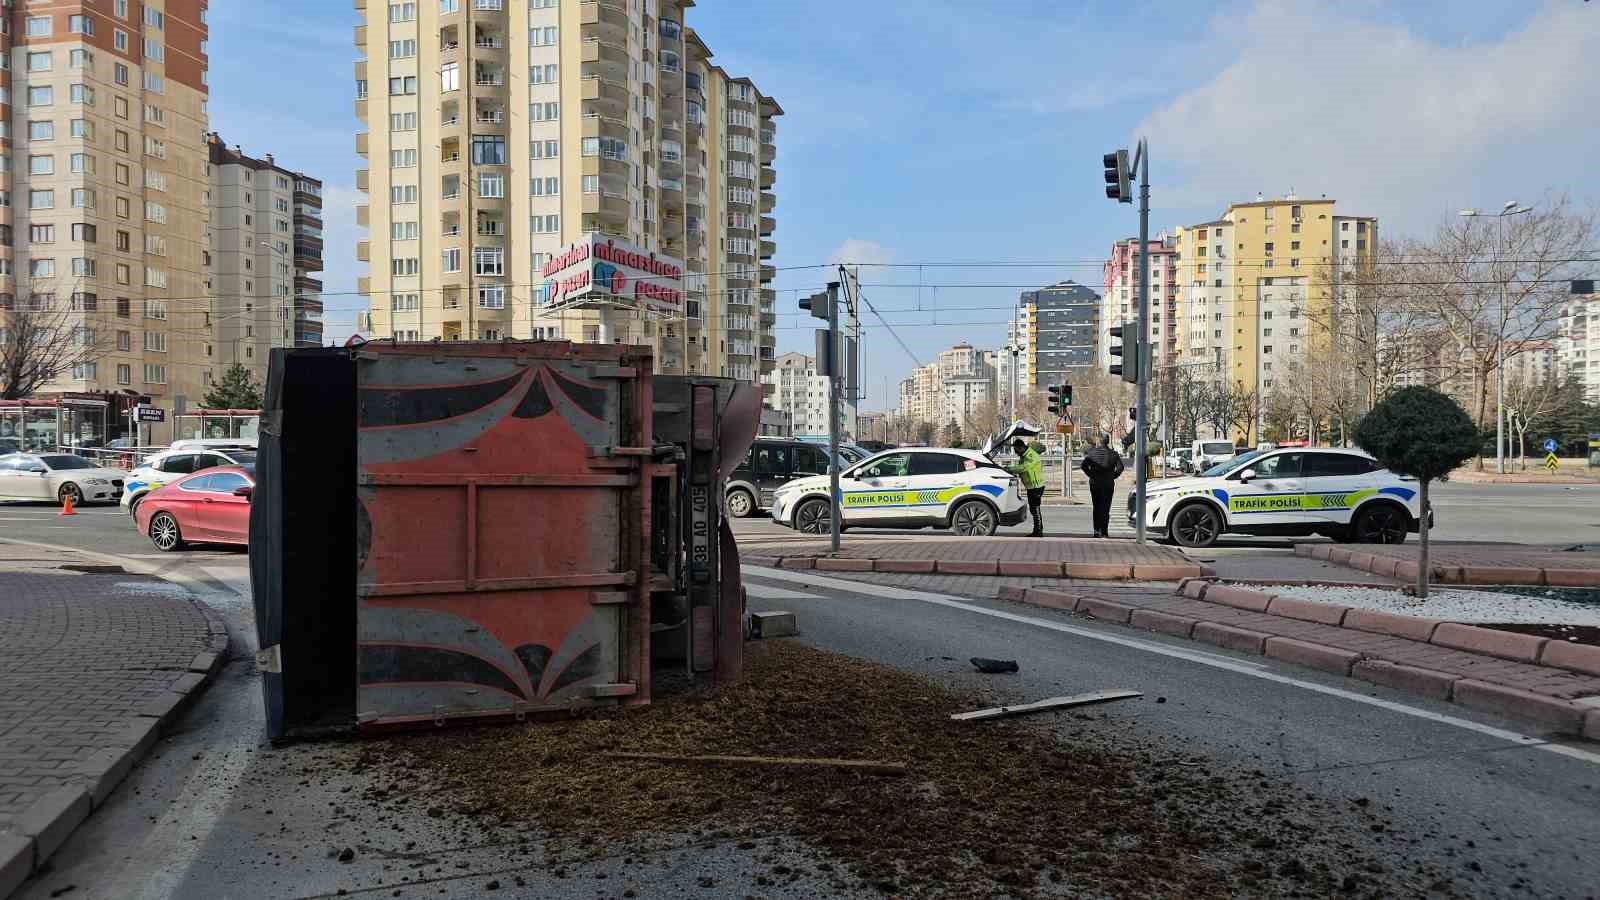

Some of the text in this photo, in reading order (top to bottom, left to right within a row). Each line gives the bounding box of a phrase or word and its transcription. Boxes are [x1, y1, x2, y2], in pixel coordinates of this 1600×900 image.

[593, 239, 681, 280] mimarsinan
[693, 488, 706, 512] 405
[1234, 497, 1301, 508] TRAFİK POLİSİ
[694, 545, 706, 561] 38
